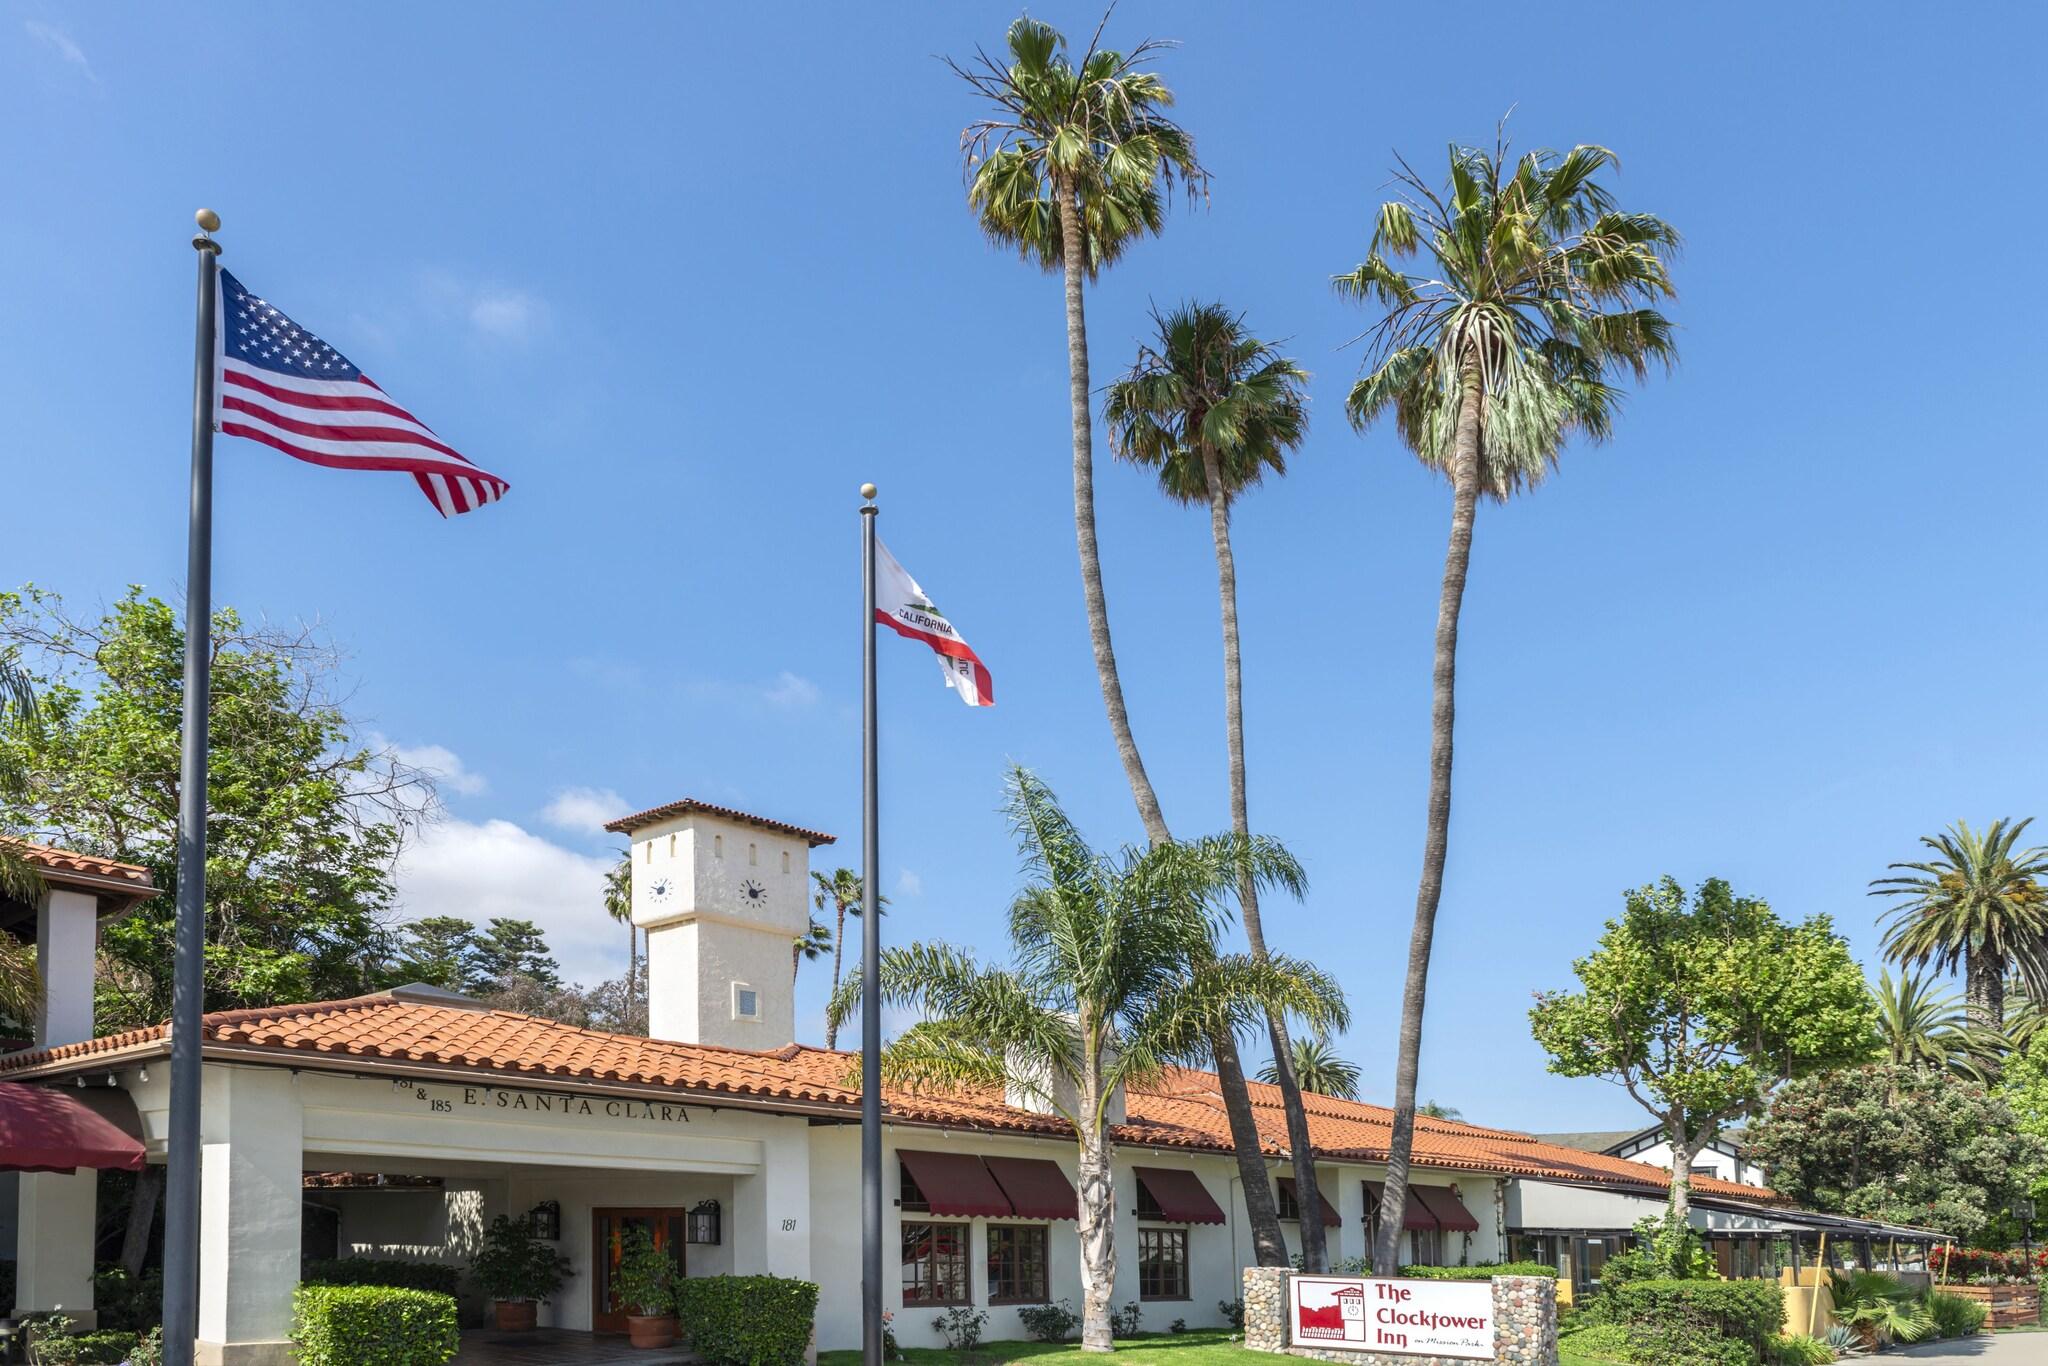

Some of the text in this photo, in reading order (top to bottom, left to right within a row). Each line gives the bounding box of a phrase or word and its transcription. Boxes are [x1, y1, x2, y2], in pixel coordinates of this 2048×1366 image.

[899, 608, 953, 635] CALIFORNIA
[416, 1087, 428, 1101] &
[431, 1099, 453, 1113] 185
[496, 1091, 593, 1115] SANTA
[605, 1101, 690, 1123] CLARA
[782, 1218, 797, 1232] 181
[1375, 1283, 1412, 1304] The
[1376, 1307, 1488, 1331] Clocktower
[1377, 1328, 1408, 1349] Inn
